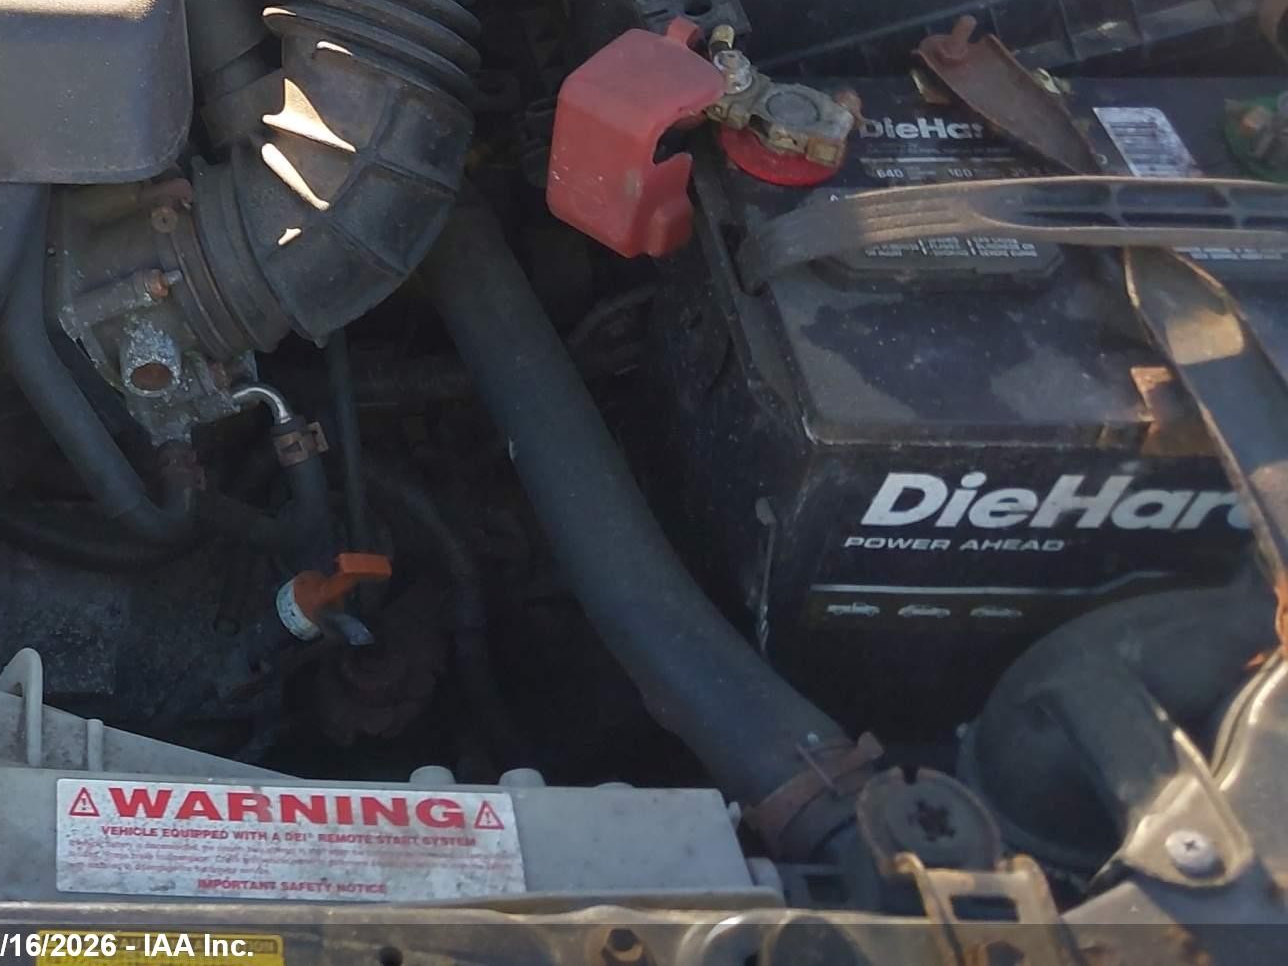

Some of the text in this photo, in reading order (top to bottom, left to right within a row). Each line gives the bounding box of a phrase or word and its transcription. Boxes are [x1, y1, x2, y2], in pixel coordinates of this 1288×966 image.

[859, 117, 985, 139] DieHar
[844, 537, 1064, 552] POWER AHEAD
[108, 787, 465, 829] WARNING
[100, 825, 157, 838] VEHICLE
[162, 828, 229, 840] EQUIPPED
[234, 830, 268, 842] WITH
[272, 832, 281, 842] A
[318, 833, 374, 844] REMOTE
[376, 835, 419, 845] START
[422, 836, 477, 847] SYSTEM
[197, 878, 387, 895] IMPORTANT SAFETY NOTICE
